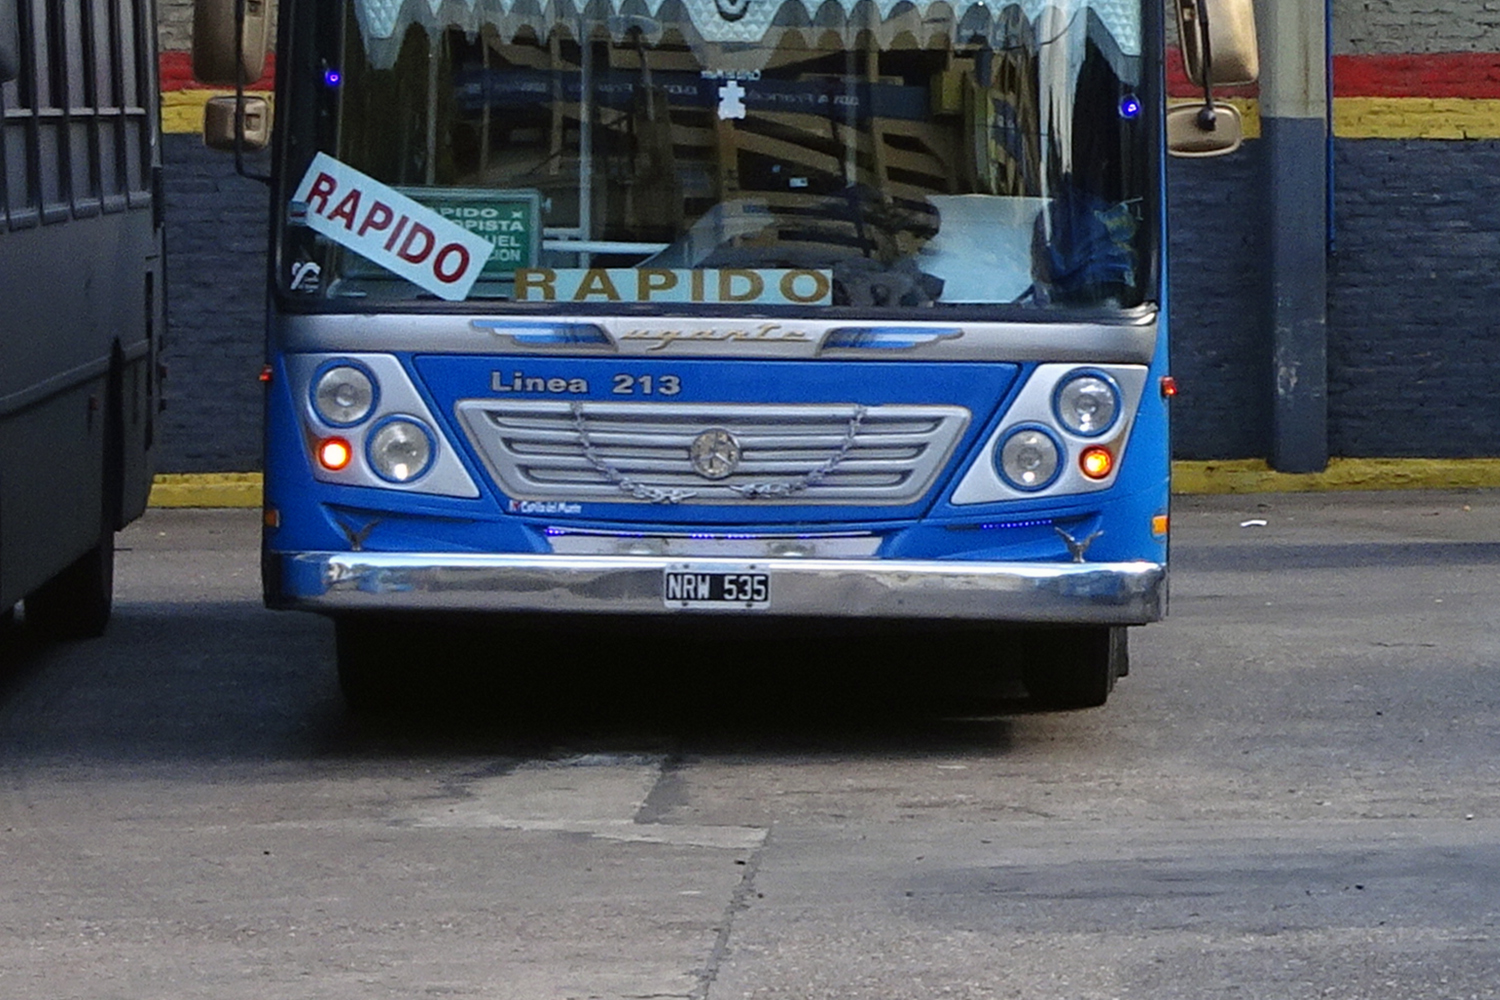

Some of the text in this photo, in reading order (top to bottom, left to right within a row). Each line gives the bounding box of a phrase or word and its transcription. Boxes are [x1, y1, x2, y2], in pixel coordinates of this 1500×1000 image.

[437, 207, 499, 218] PIDO
[304, 171, 470, 284] RAPIDO
[513, 268, 831, 303] RAPIDO
[490, 370, 682, 396] Linea 213
[666, 573, 767, 602] NRW 535
